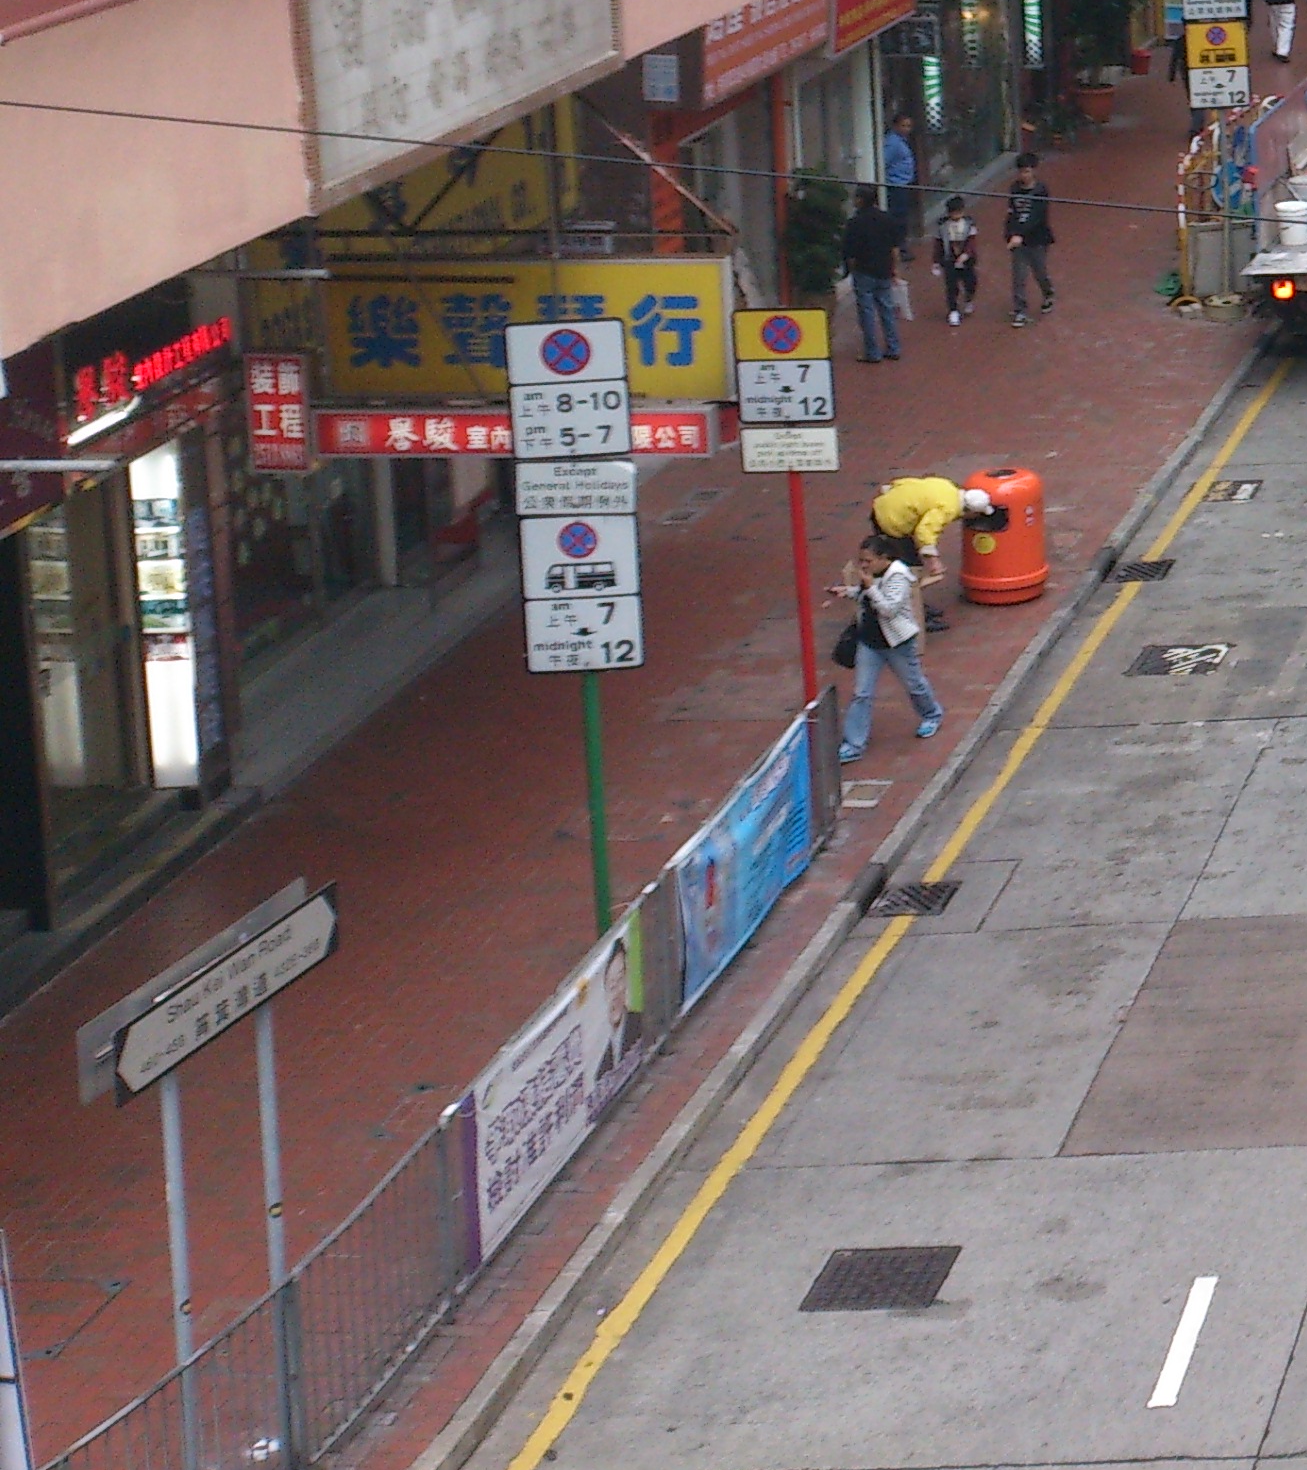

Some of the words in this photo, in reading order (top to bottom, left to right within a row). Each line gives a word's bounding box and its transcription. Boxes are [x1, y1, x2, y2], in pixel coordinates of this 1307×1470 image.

[1226, 70, 1237, 82] 7
[1228, 91, 1246, 104] 12
[797, 364, 811, 383] 7
[519, 403, 551, 419] 上午
[524, 391, 543, 401] am
[556, 389, 622, 414] 8-10
[797, 396, 828, 417] 12
[253, 404, 304, 438] 工程
[525, 426, 546, 437] pm
[559, 424, 612, 447] 5-7
[522, 480, 571, 493] General
[574, 480, 630, 493] Holidays
[551, 601, 571, 612] am
[597, 601, 616, 626] 7
[533, 639, 594, 653] midnight
[600, 639, 636, 664] 12
